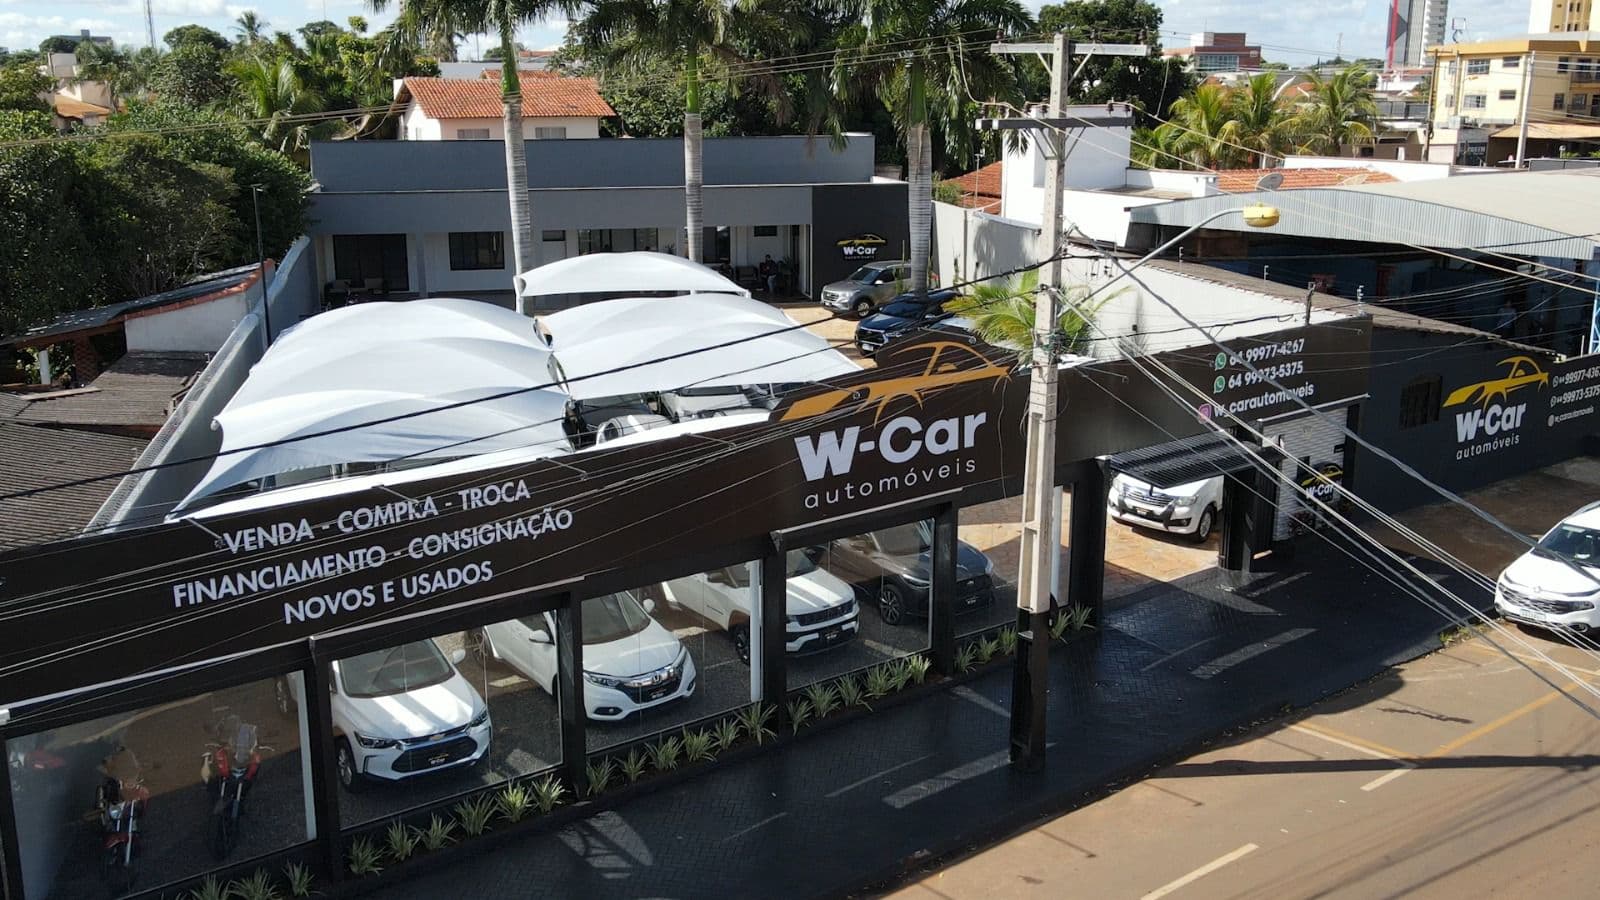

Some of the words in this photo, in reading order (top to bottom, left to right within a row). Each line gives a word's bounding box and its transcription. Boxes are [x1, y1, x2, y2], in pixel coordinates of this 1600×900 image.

[843, 246, 877, 256] W-Car
[1228, 373, 1242, 389] 64
[793, 412, 987, 482] W-Car
[1456, 402, 1527, 443] W-Car
[1456, 432, 1520, 461] automóveis
[804, 458, 976, 509] automóveis
[223, 518, 316, 555] VENDA
[337, 495, 439, 534] COMPRA
[458, 479, 531, 511] TROCA
[173, 545, 386, 608] FINANCIAMENTO
[408, 508, 574, 550] CONSIGNAÇÃO
[284, 585, 376, 625] NOVOS
[383, 581, 396, 603] E
[402, 560, 494, 599] USADOS
